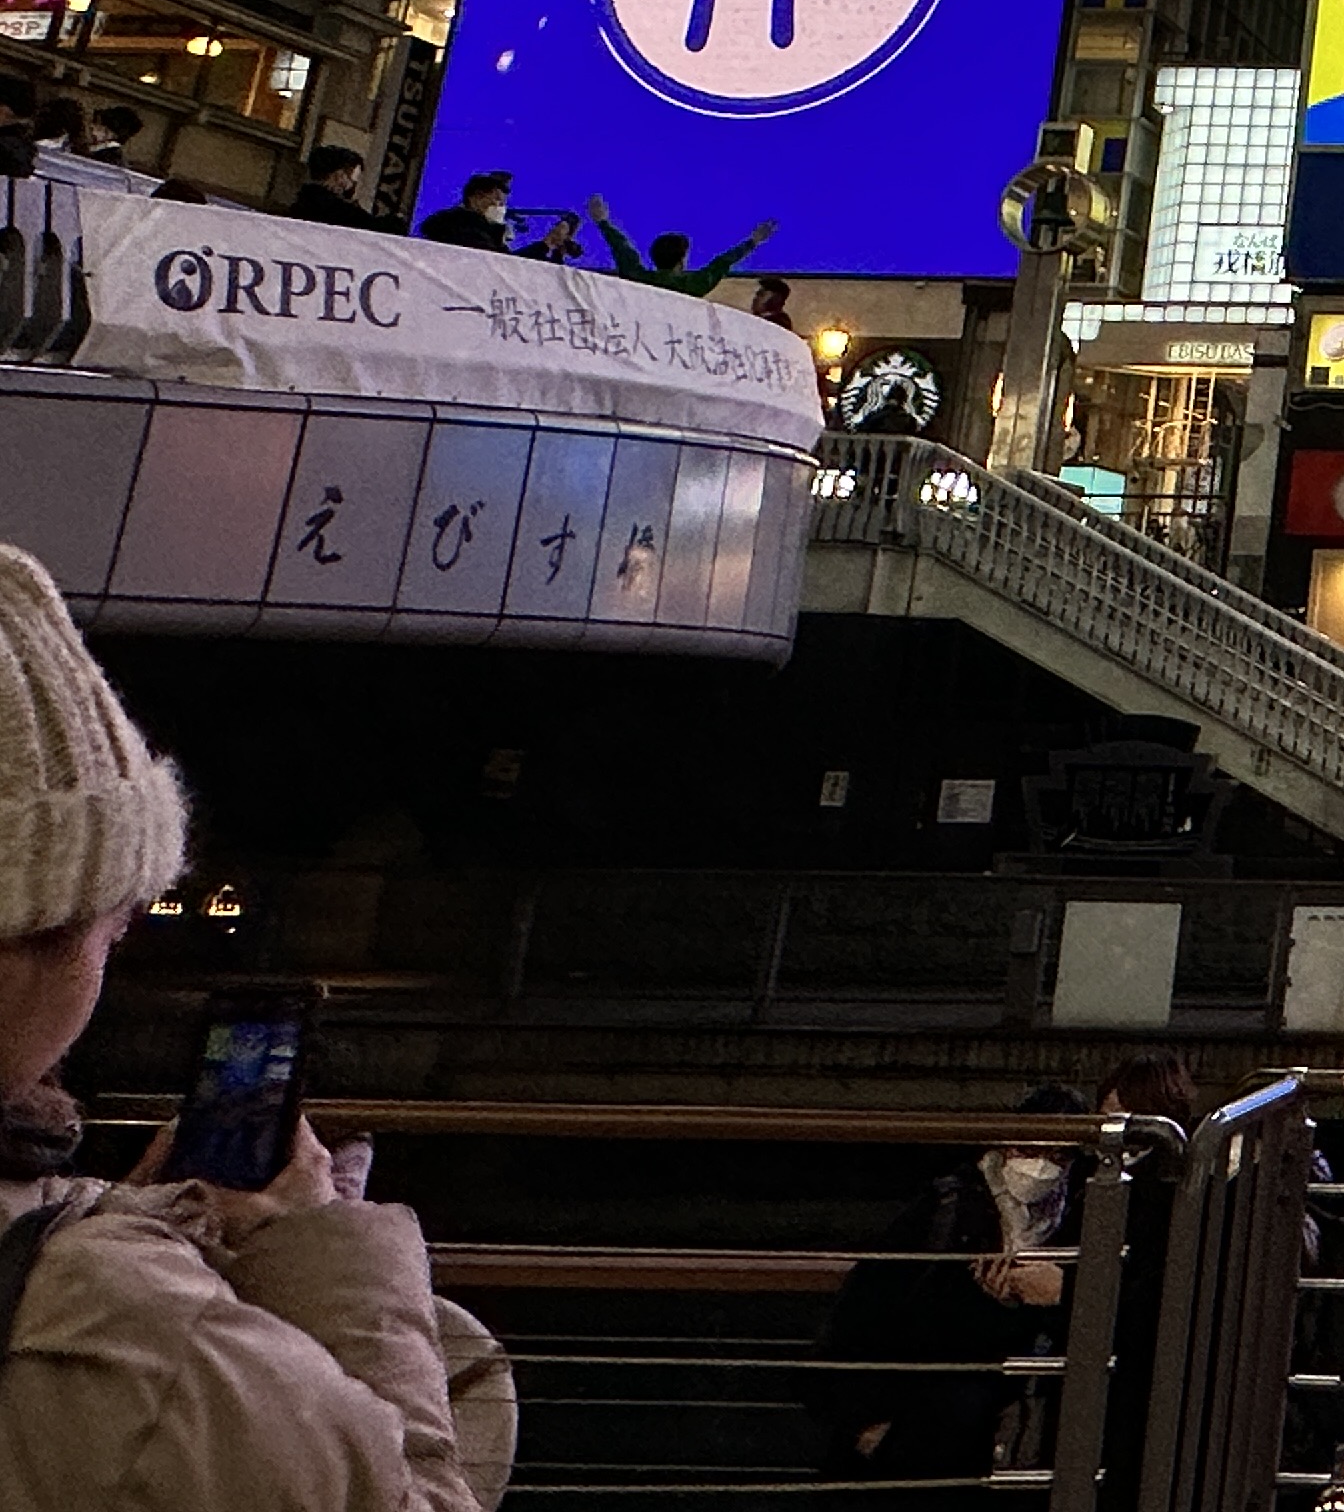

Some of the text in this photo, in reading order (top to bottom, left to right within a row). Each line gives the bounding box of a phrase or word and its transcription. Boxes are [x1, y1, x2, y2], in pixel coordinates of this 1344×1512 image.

[442, 289, 658, 363] 一般社団法人
